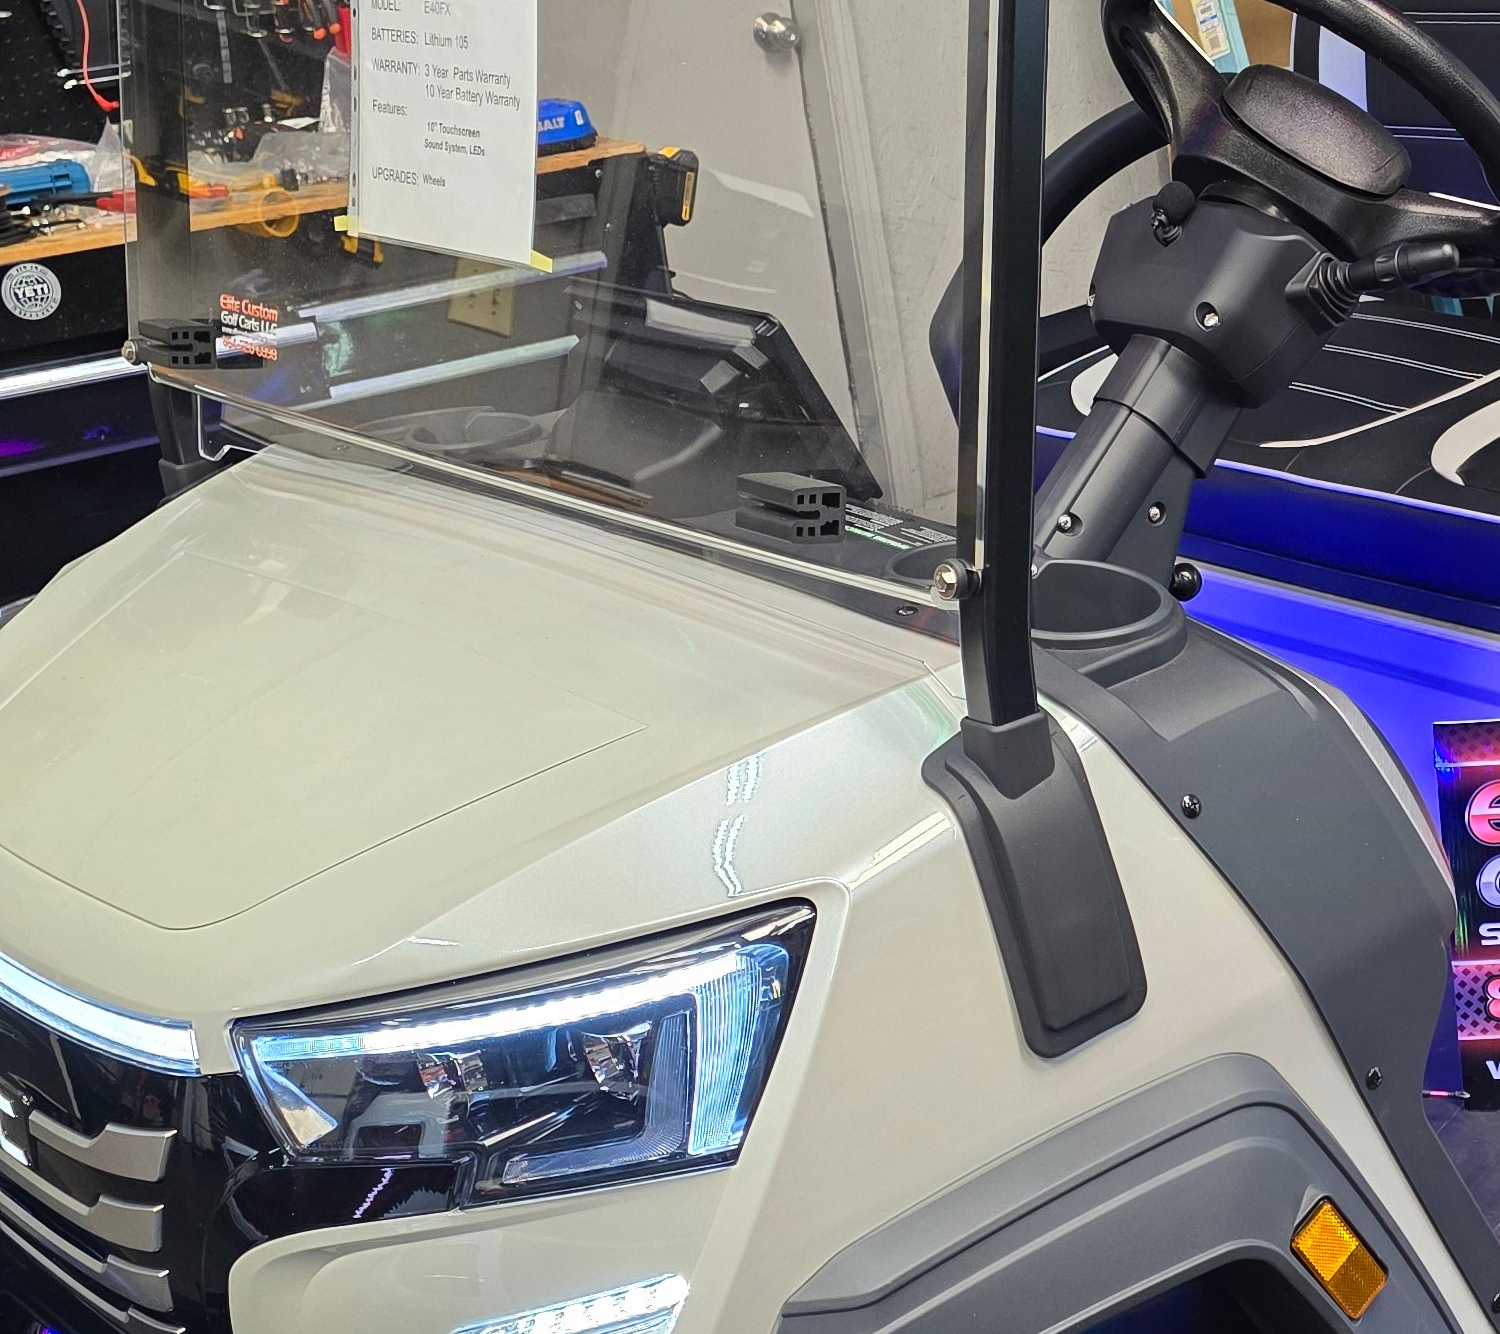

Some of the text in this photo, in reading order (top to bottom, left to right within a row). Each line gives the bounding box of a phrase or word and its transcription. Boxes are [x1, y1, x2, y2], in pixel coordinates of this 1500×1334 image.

[423, 0, 451, 16] E40FX
[371, 27, 469, 49] BATTERIES: Lithium 105
[371, 58, 511, 89] WARRANTY: 3 Year Parts Warranty
[372, 99, 408, 116] Features:
[425, 84, 521, 112] 10 Year Battery Warranty
[427, 121, 480, 138] 10" Touchscreen
[424, 138, 485, 157] Sound System, LEDs
[372, 166, 446, 187] UPGRADES: Wheels
[14, 283, 49, 299] YETI
[220, 310, 238, 327] Golf
[238, 315, 260, 332] Carts
[241, 298, 278, 323] Custom
